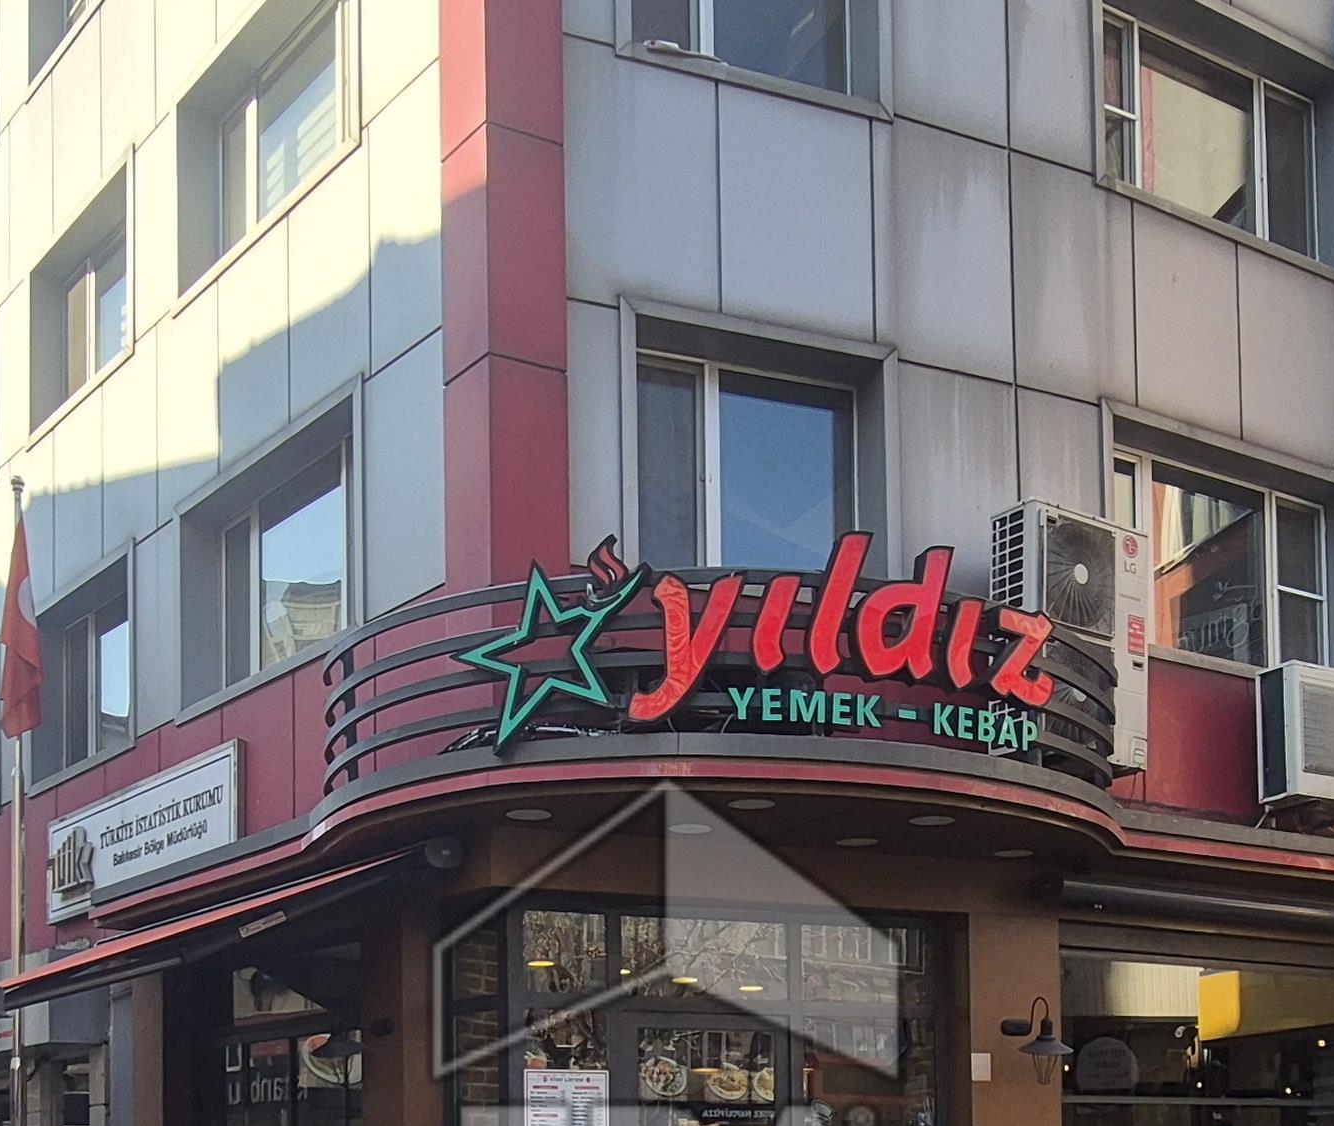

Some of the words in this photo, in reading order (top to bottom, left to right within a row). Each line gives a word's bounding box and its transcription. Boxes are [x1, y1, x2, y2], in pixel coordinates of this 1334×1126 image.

[627, 531, 1055, 722] yıldız
[727, 686, 883, 728] YEMEK
[932, 702, 1040, 752] KEBAP
[99, 819, 134, 850] TÜRKİYE
[135, 799, 181, 837] İSTATİSTİK
[183, 784, 223, 819] KURUMU
[113, 844, 142, 867] Balıkesir
[144, 838, 165, 856] Bölge
[167, 819, 208, 848] Müdürlüğü
